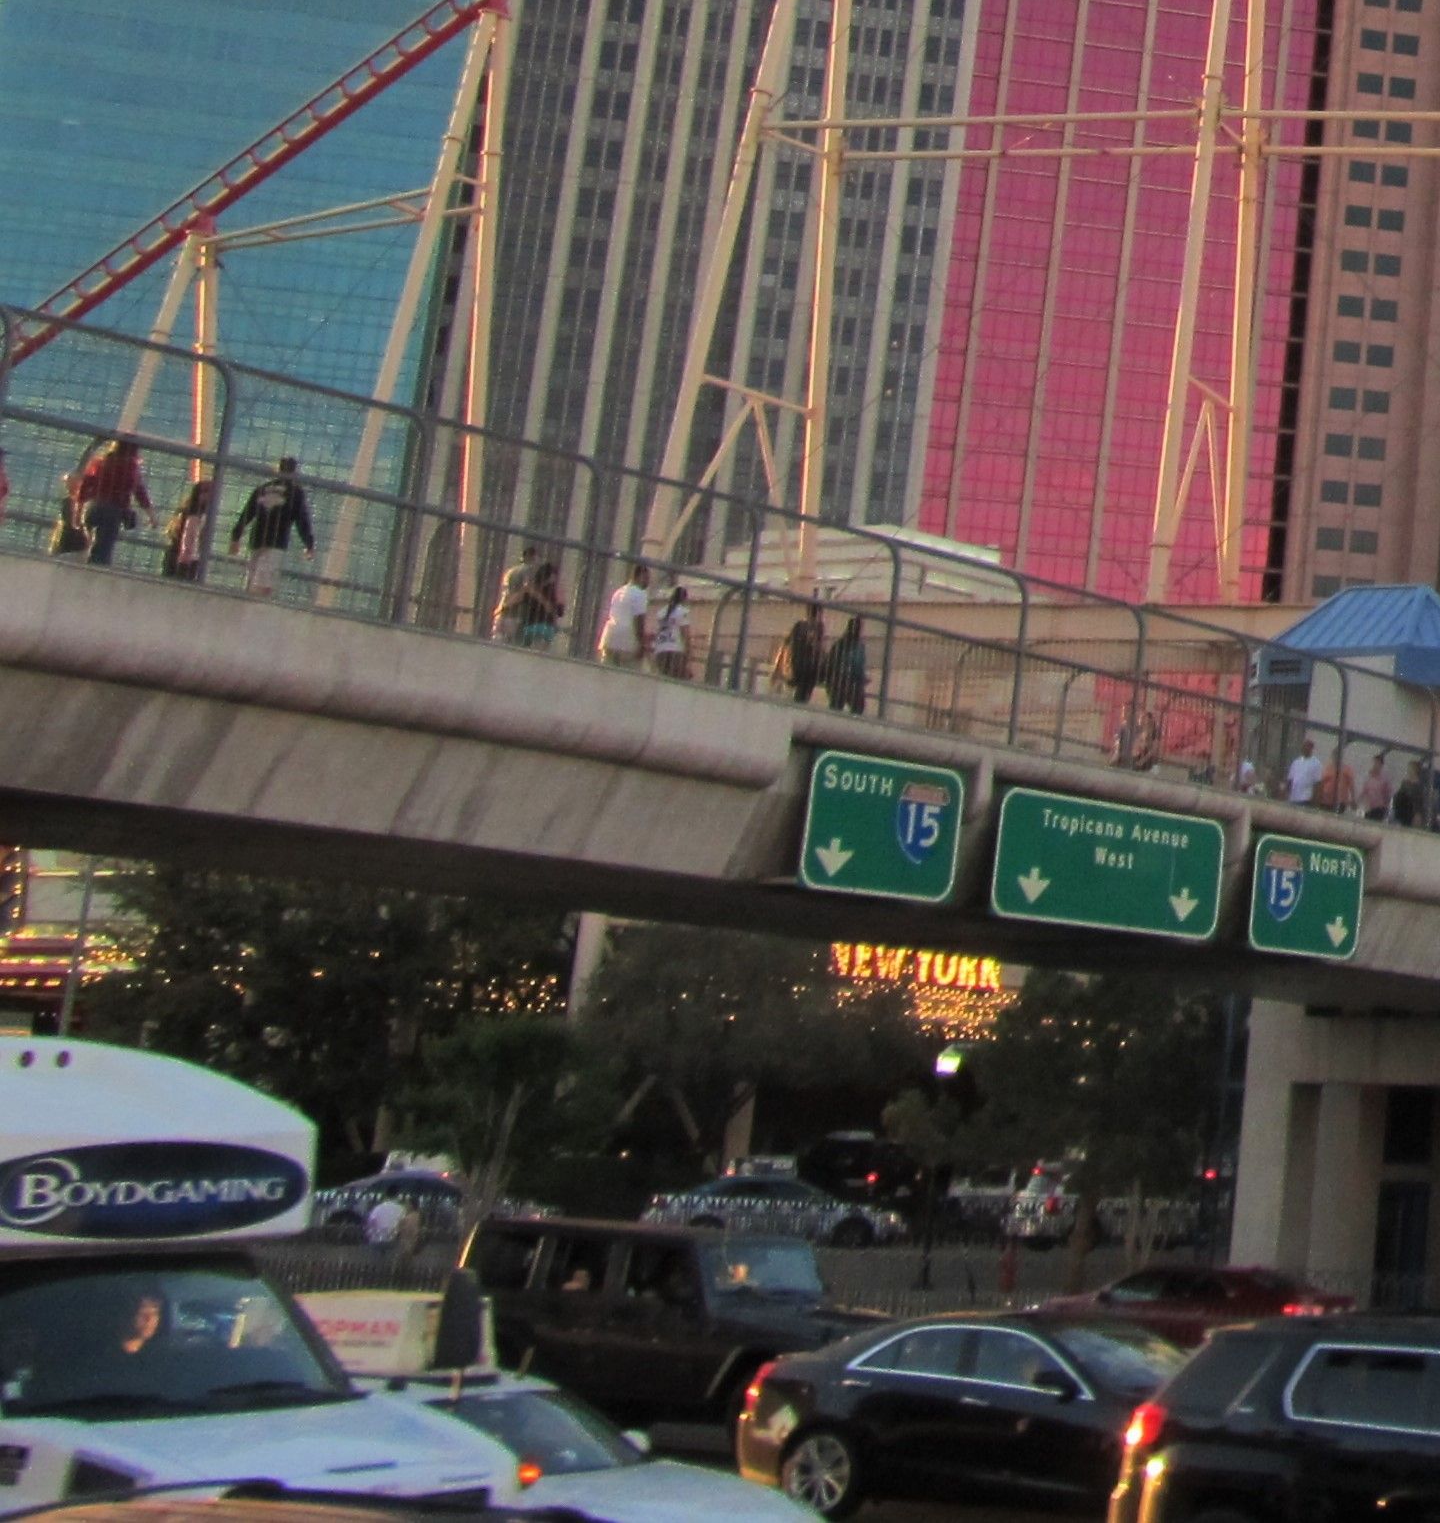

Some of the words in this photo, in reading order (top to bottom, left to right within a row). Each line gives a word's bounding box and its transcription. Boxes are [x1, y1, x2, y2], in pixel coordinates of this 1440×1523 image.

[824, 763, 894, 798] SOUTH
[906, 803, 941, 848] 15
[1043, 808, 1124, 839] Tropicana
[1131, 824, 1190, 849] Avenue
[1094, 845, 1135, 870] West
[1270, 868, 1296, 907] 15
[1309, 851, 1358, 879] NORTH
